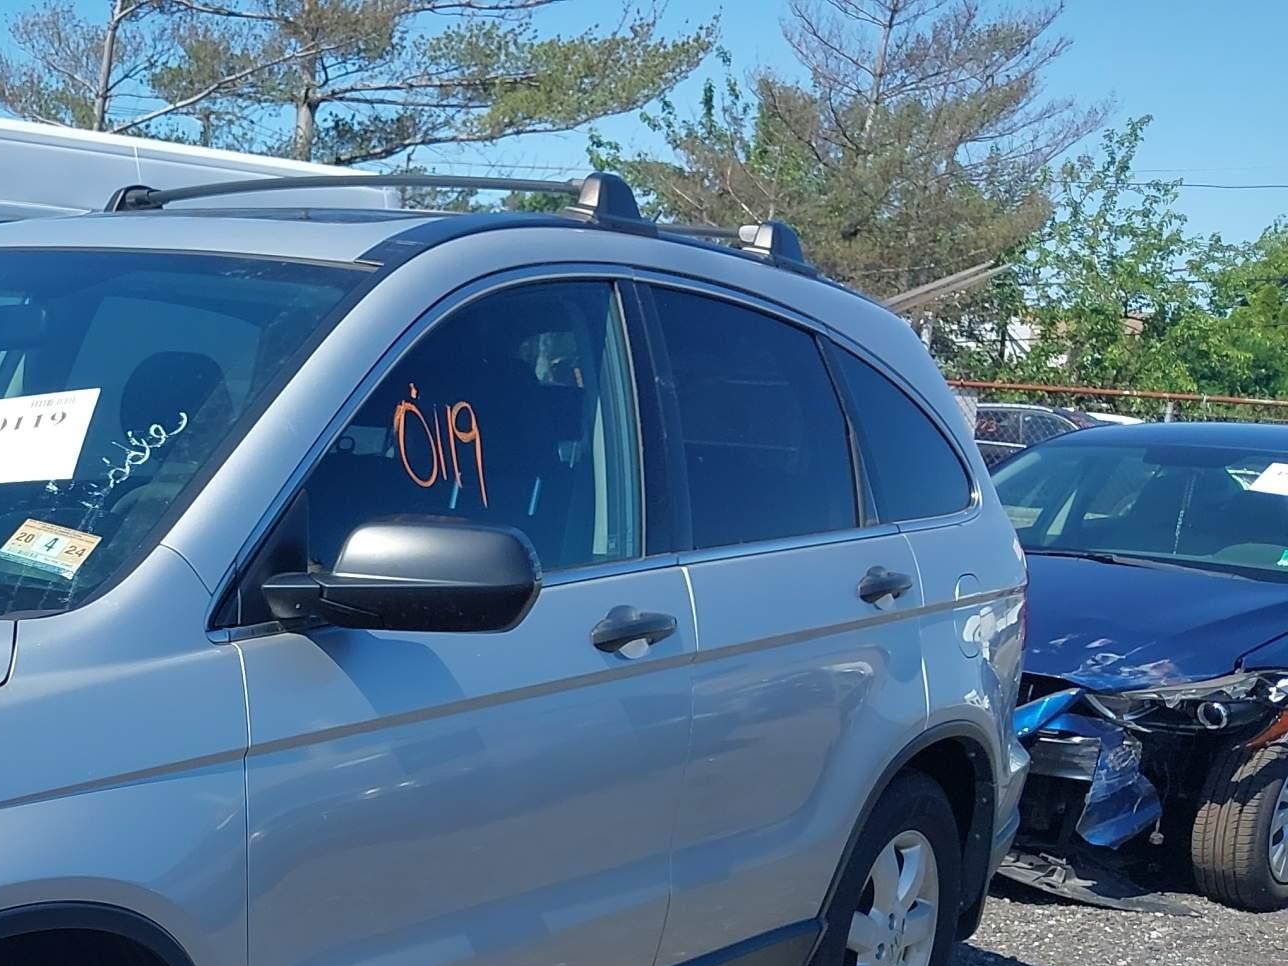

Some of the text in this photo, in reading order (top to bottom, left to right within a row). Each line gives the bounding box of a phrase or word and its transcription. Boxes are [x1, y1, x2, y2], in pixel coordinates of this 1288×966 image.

[394, 400, 487, 508] 0119
[15, 531, 36, 544] 20
[44, 537, 59, 552] 4
[64, 545, 87, 558] 24
